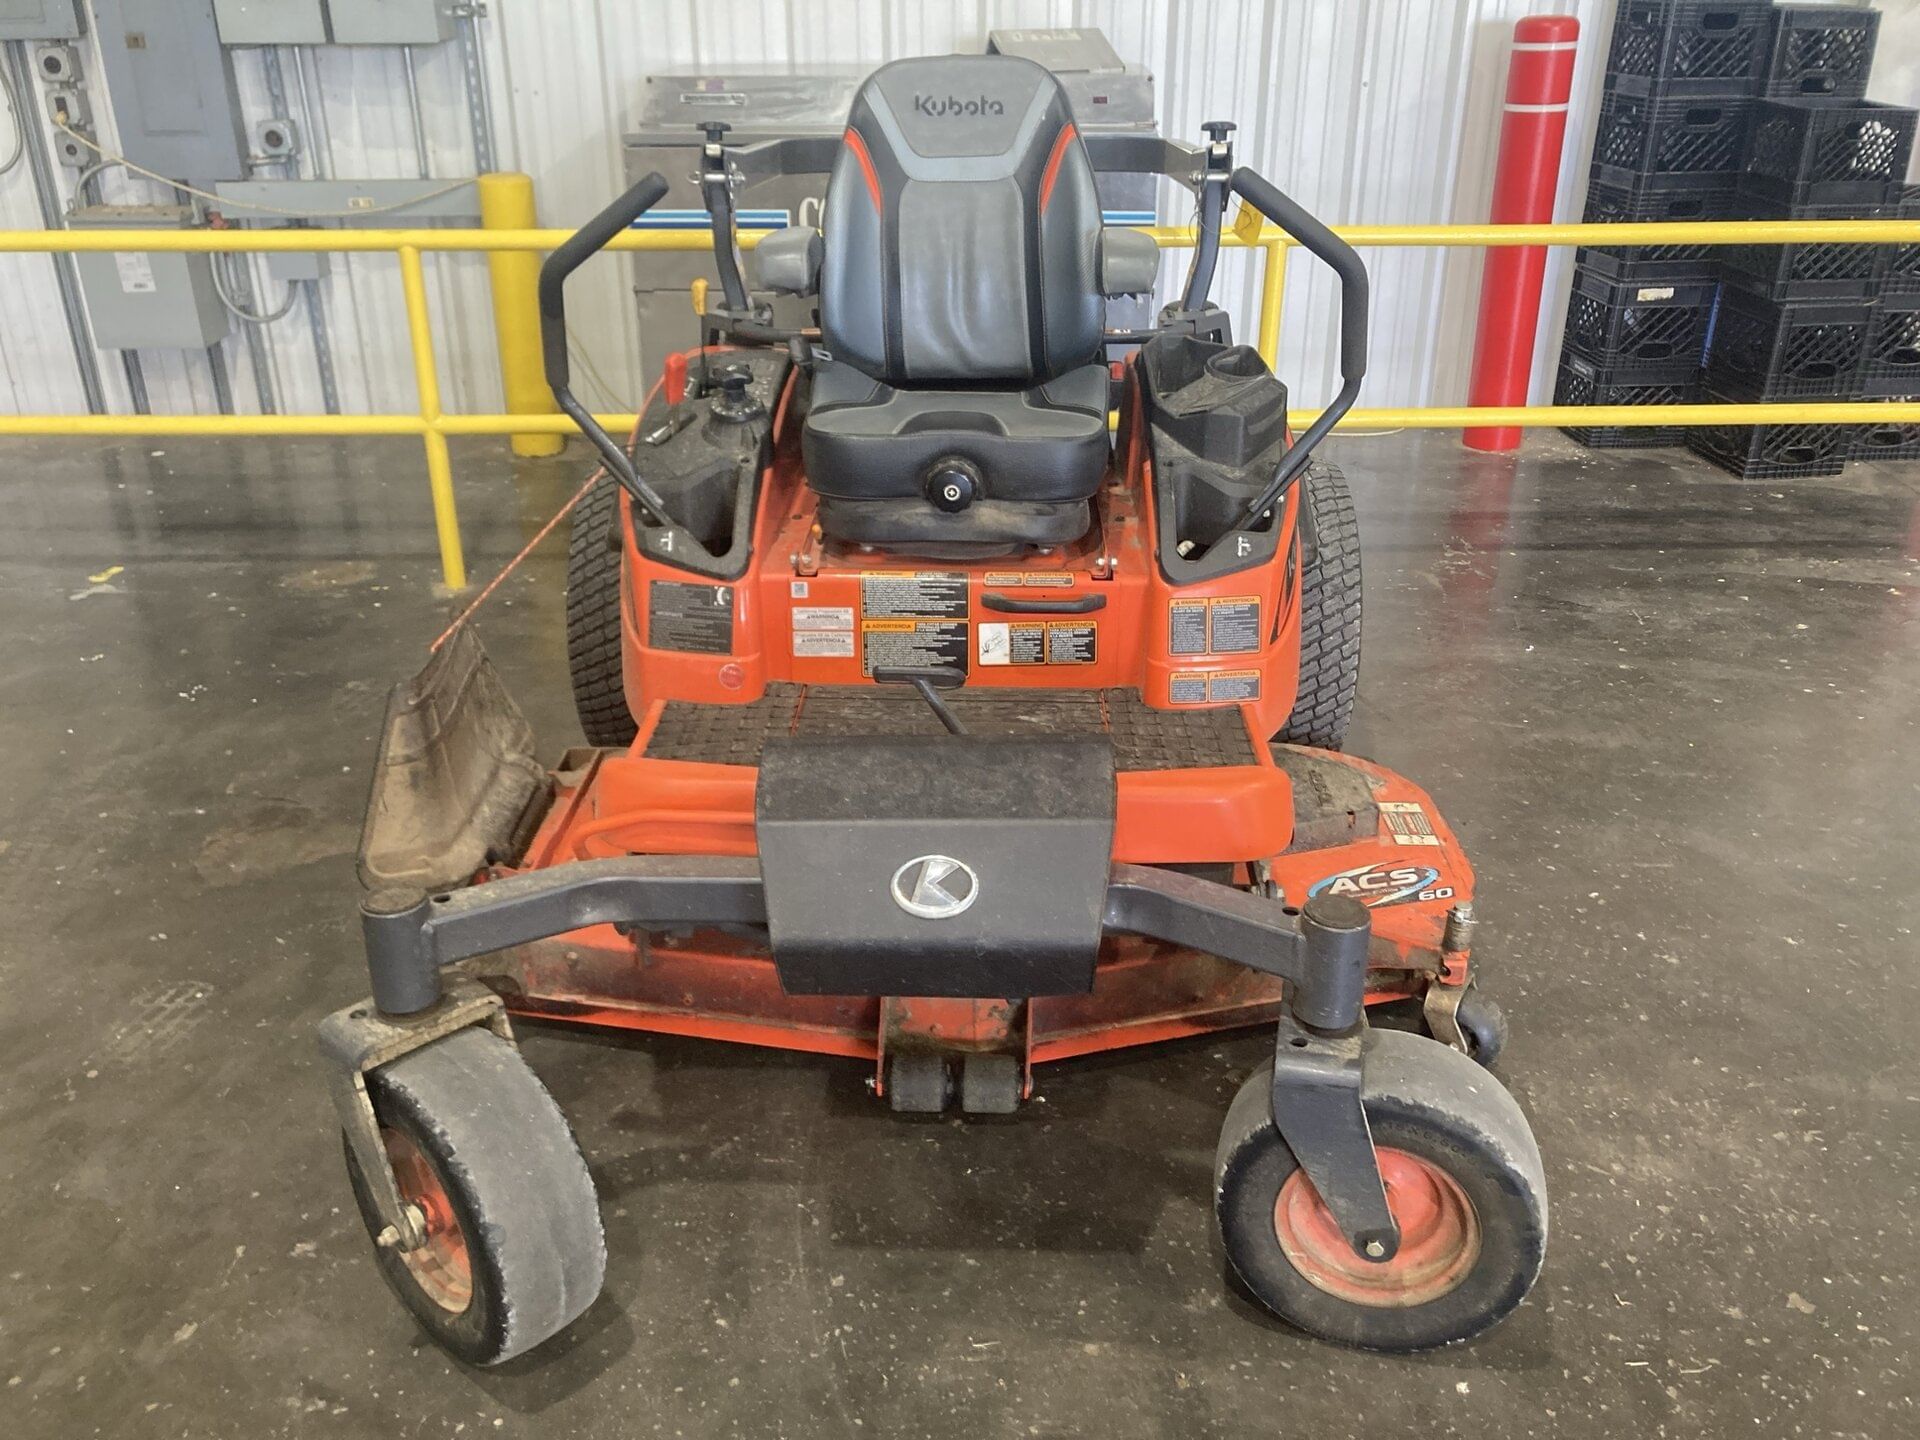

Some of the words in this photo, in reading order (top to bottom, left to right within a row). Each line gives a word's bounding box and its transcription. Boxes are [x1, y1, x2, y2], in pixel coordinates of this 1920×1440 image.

[914, 94, 1004, 117] Kubota
[1328, 867, 1418, 895] ACS
[1418, 887, 1453, 901] 60
